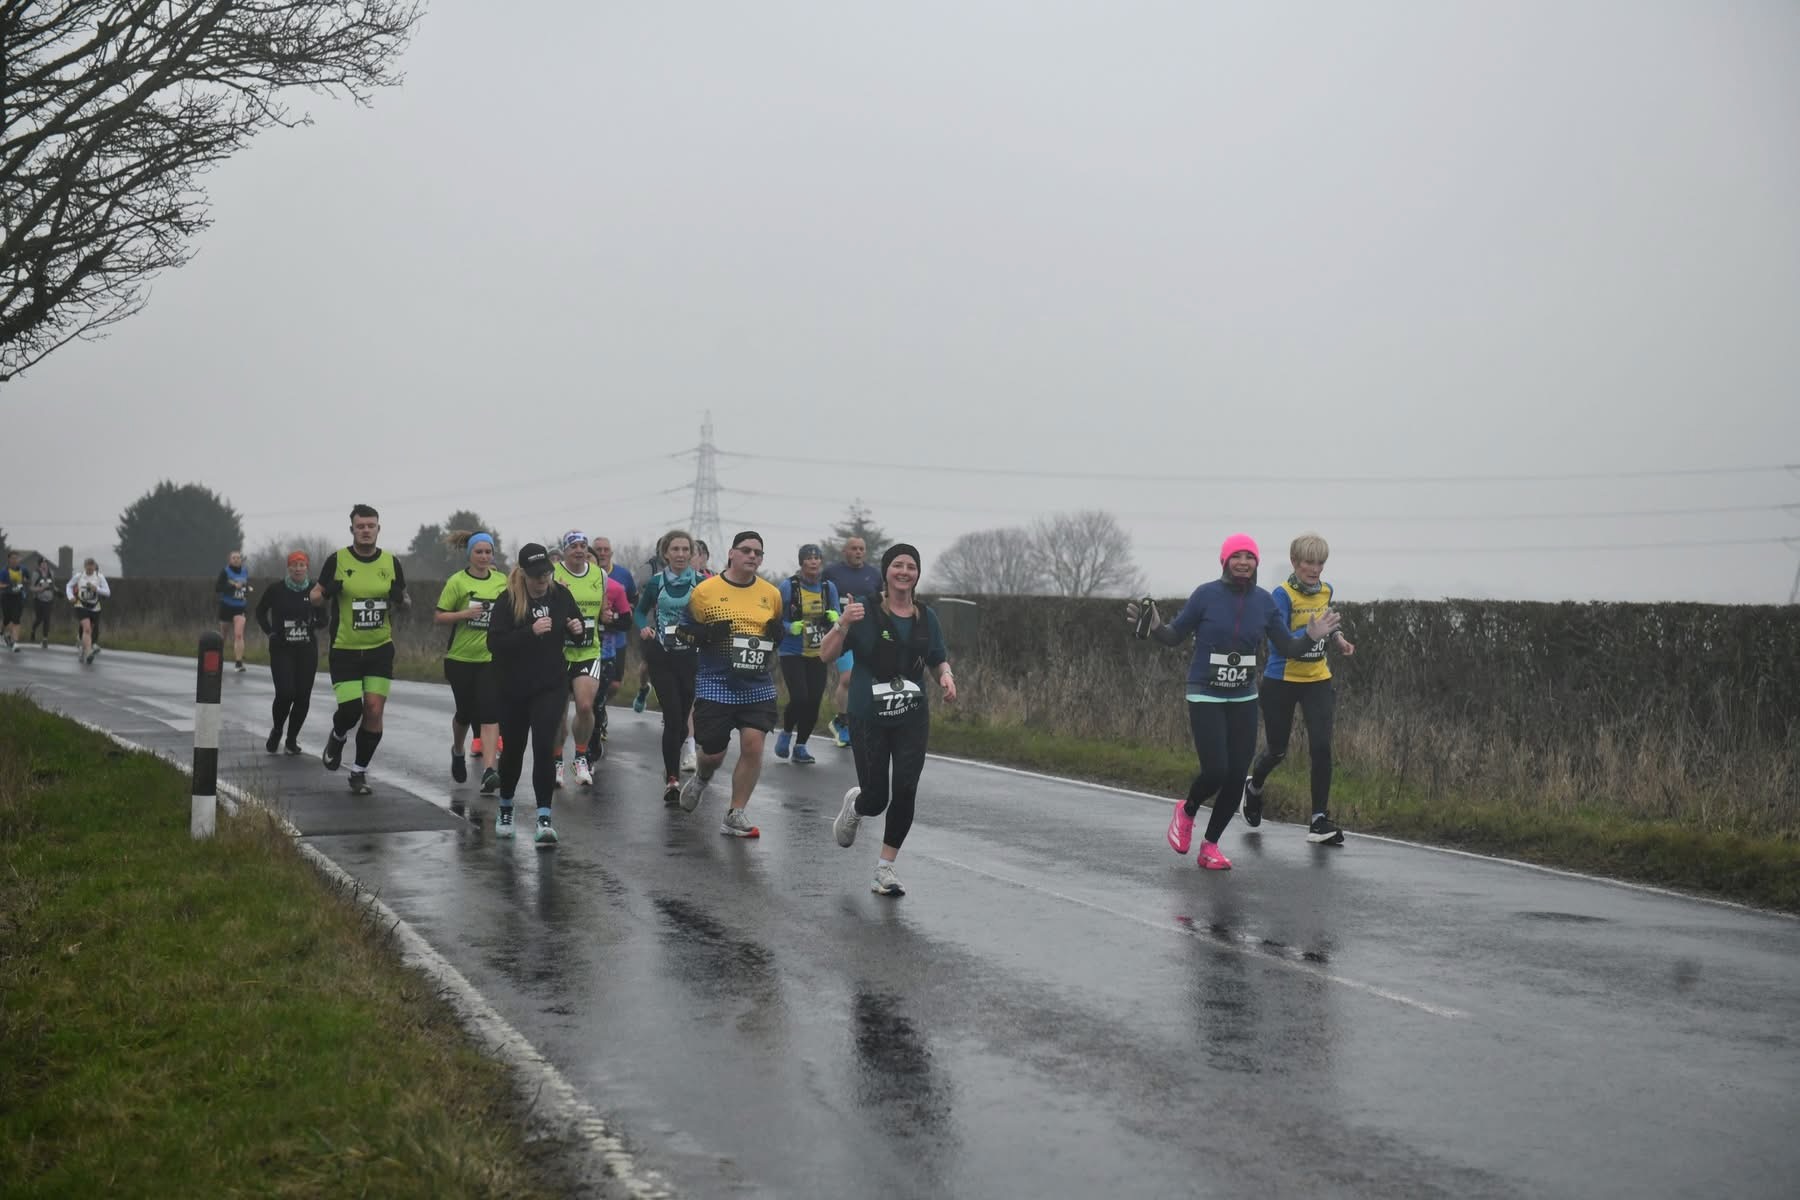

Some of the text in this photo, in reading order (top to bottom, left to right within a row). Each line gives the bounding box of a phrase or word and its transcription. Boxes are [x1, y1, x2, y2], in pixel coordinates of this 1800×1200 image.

[359, 610, 380, 622] 116
[289, 627, 307, 636] 444
[739, 649, 765, 664] 138
[1216, 667, 1247, 682] 504
